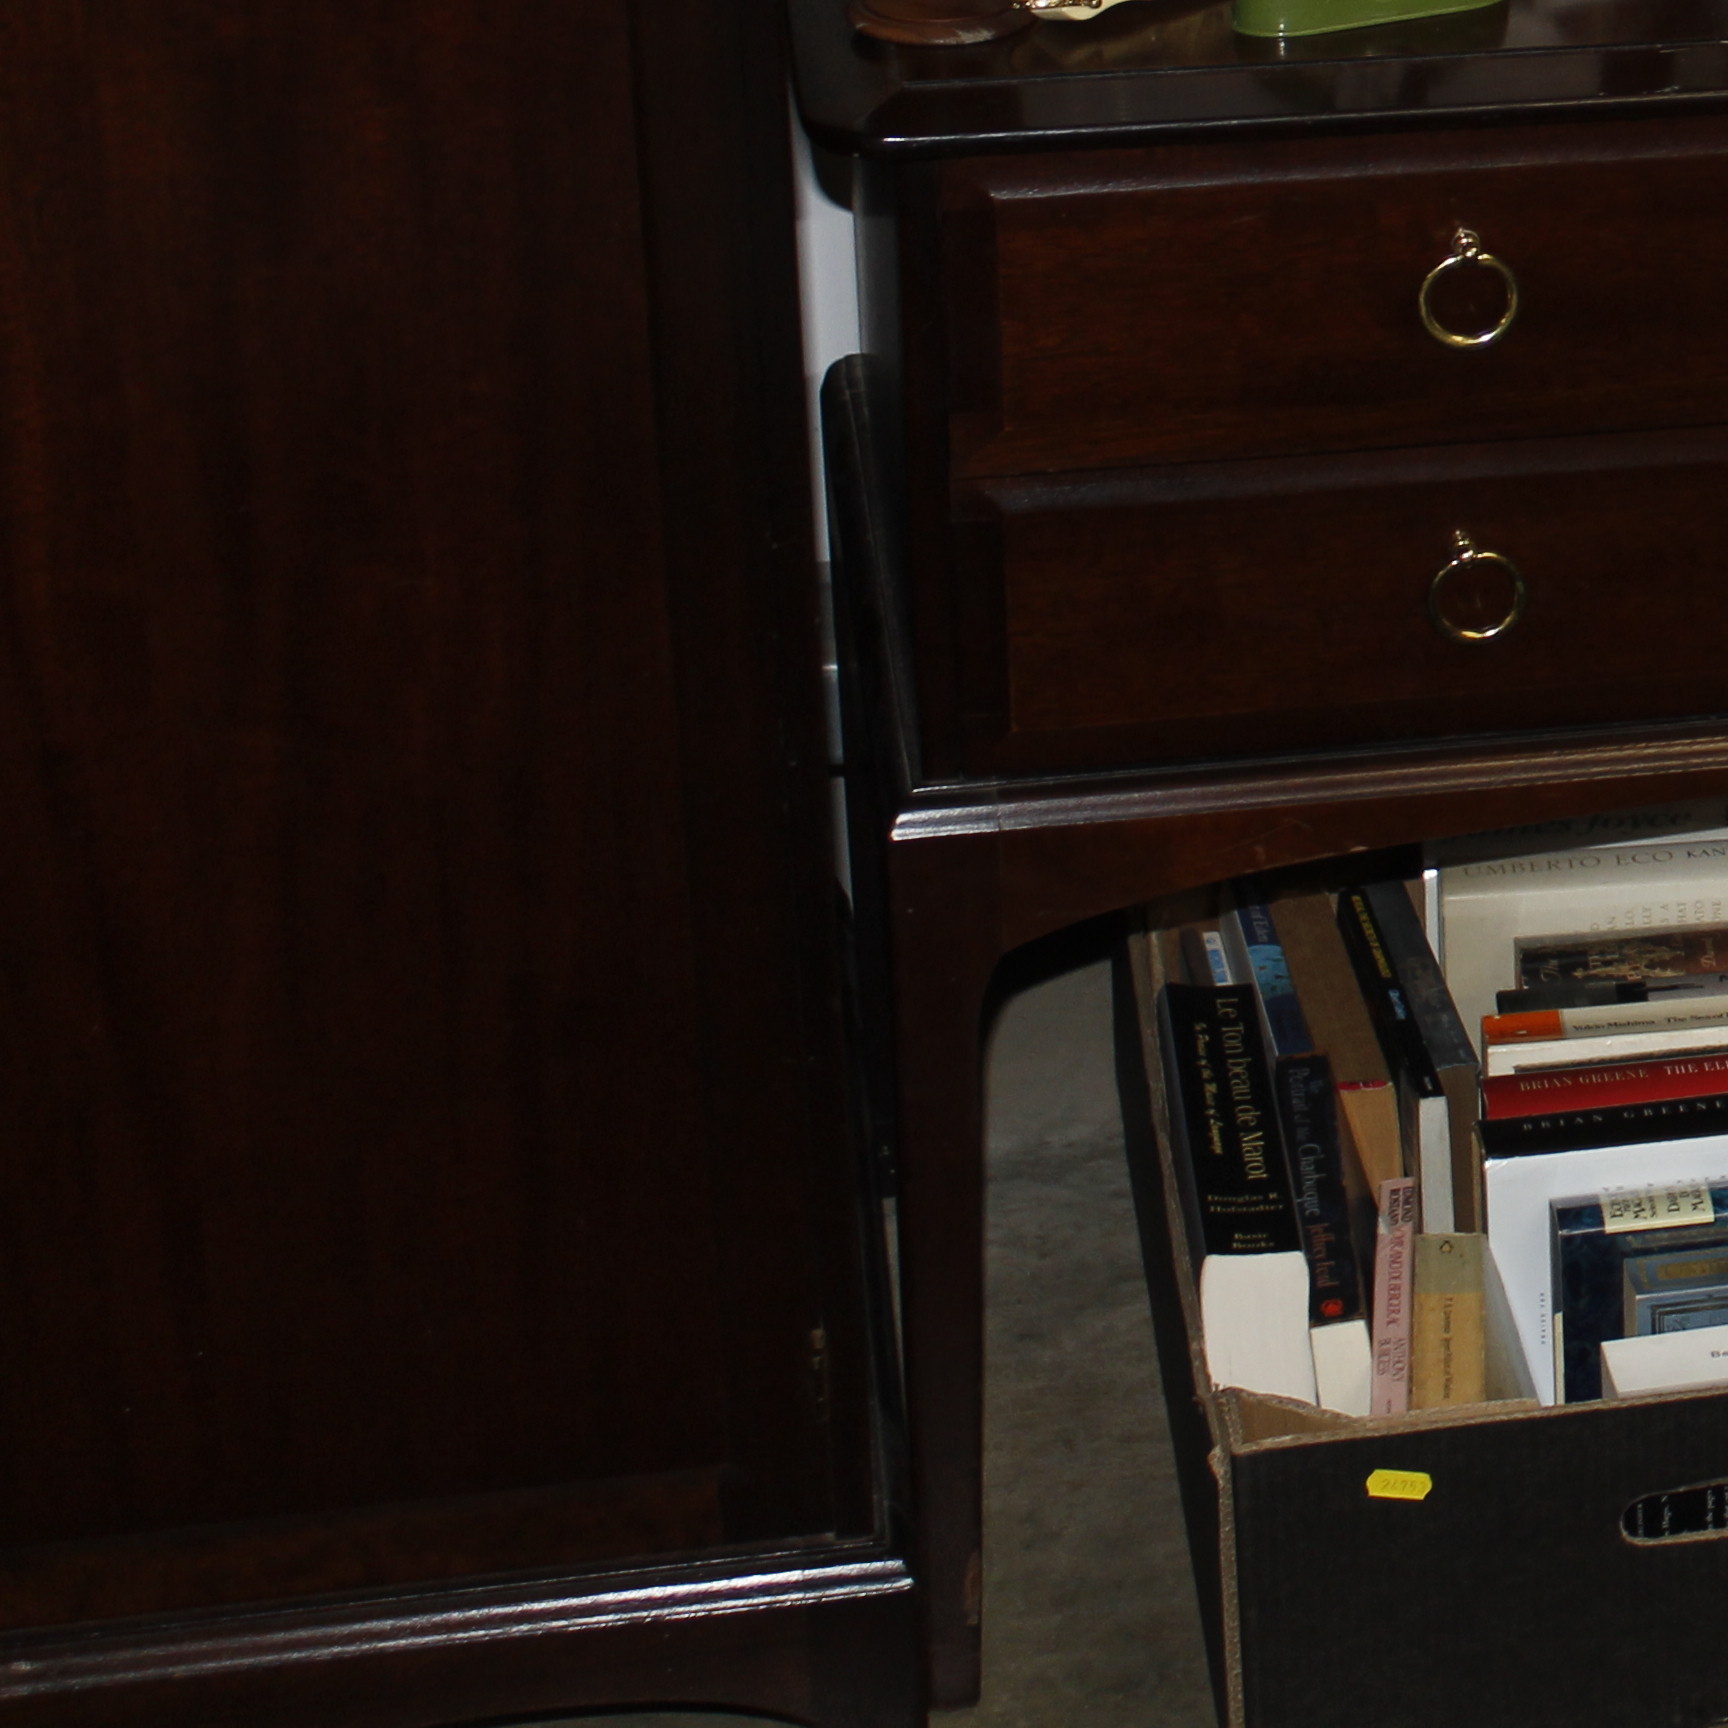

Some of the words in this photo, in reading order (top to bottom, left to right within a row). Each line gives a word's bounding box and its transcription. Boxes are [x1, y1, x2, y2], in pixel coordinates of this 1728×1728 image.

[1464, 854, 1601, 878] UMBERTO
[1616, 849, 1674, 866] ECO
[1214, 997, 1239, 1019] Le
[1220, 1021, 1246, 1055] Ton
[1606, 1018, 1656, 1030] Mishima
[1226, 1057, 1255, 1103] beau
[1519, 1075, 1573, 1091] BRIAN
[1579, 1068, 1650, 1084] GREENE
[1664, 1062, 1698, 1076] THE
[1237, 1104, 1262, 1130] de
[1522, 1114, 1604, 1131] BRIAN
[1623, 1100, 1727, 1119] GREENE
[1238, 1129, 1268, 1182] Marot
[1290, 1142, 1326, 1217] Charbuque
